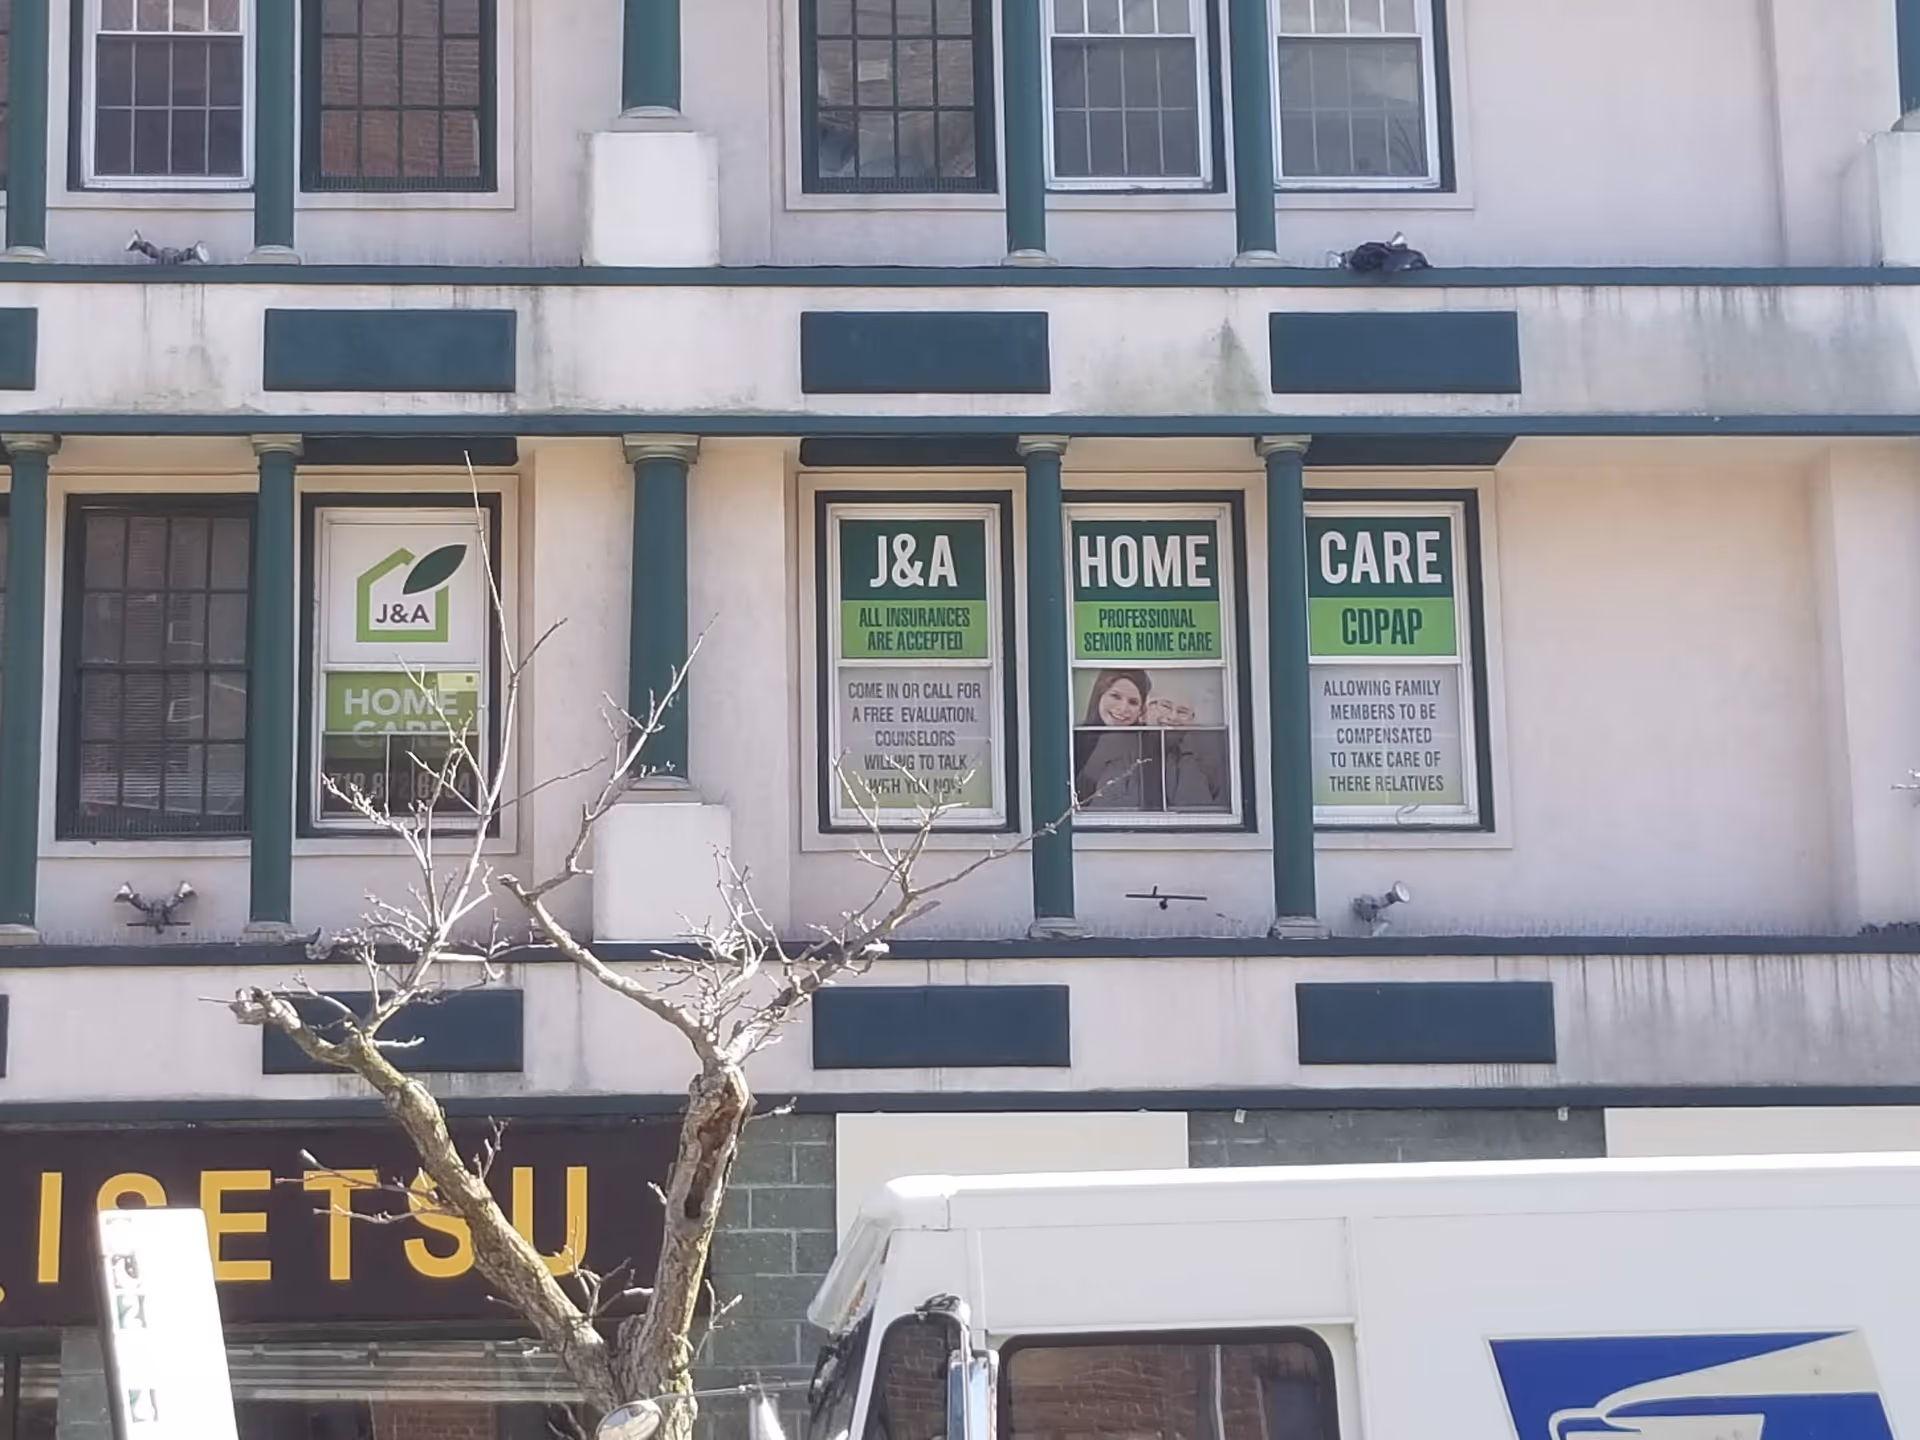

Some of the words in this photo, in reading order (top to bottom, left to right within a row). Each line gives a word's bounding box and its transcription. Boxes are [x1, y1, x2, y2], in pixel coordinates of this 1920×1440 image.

[869, 533, 958, 588] J&A
[1079, 535, 1212, 588] HOME
[1320, 531, 1443, 584] CARE
[375, 603, 431, 624] J&A
[859, 607, 882, 628] ALL
[886, 607, 970, 628] INSURANCES
[1099, 608, 1197, 629] PROFESSIONAL
[1342, 608, 1424, 645] CDPAP
[867, 631, 893, 651] ARE
[896, 631, 963, 651] ACCEPTED
[1084, 632, 1132, 652] SENIOR
[1136, 632, 1174, 652] HOME
[1178, 632, 1213, 651] CARE
[848, 683, 883, 699] COME
[886, 683, 899, 699] IN
[902, 683, 920, 699] OR
[923, 683, 953, 699] CALL
[957, 683, 981, 698] FOR
[1323, 680, 1391, 697] ALLOWING
[1395, 680, 1441, 696] FAMILY
[344, 688, 459, 716] HOME
[1330, 704, 1396, 721] MEMBERS
[1400, 704, 1416, 720] TO
[1420, 703, 1437, 720] BE
[852, 707, 861, 723] A
[864, 707, 894, 723] FREE
[901, 706, 978, 723] EVALUATION.
[875, 731, 956, 747] COUNSELORS
[1336, 728, 1432, 745] COMPENSATED
[919, 754, 934, 770] TO
[939, 754, 968, 770] TALK
[1329, 752, 1347, 768] TO
[1350, 752, 1382, 768] TAKE
[1387, 752, 1421, 768] CARE
[1425, 751, 1442, 767] OF
[1329, 776, 1372, 793] THERE
[1375, 775, 1445, 792] RELATIVES
